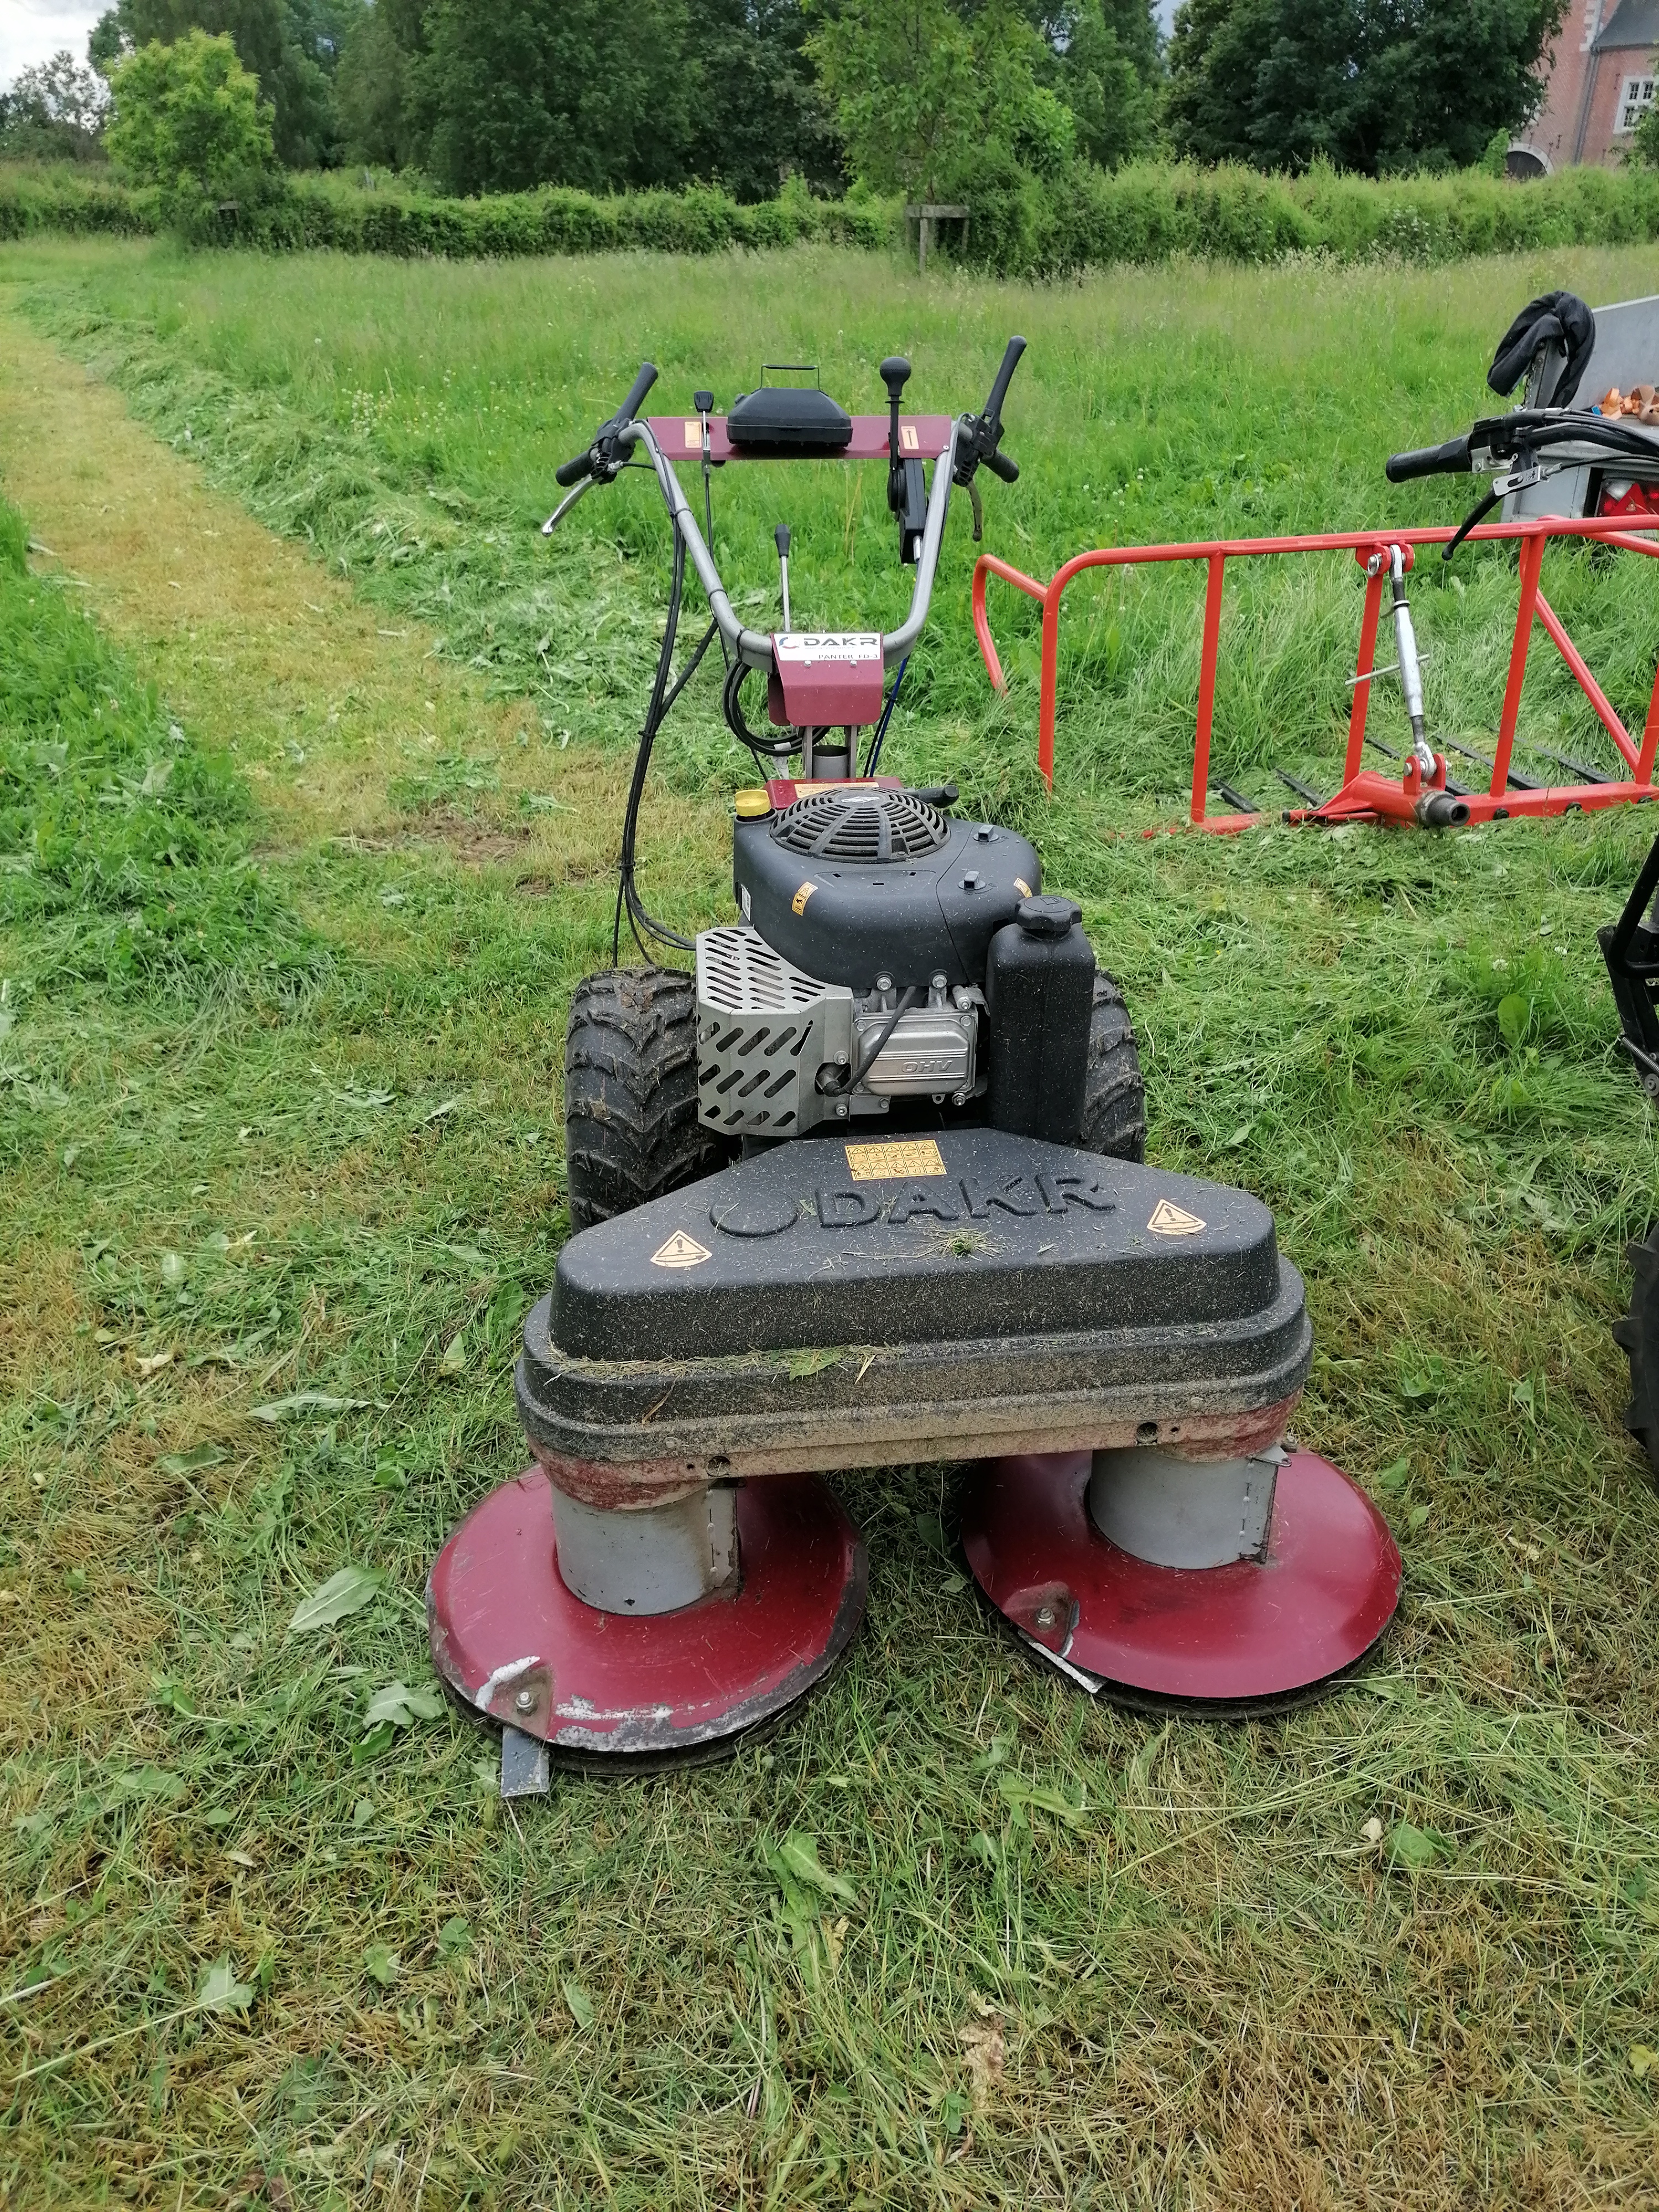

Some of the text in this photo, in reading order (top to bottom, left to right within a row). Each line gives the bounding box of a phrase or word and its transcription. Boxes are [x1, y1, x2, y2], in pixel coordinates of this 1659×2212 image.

[804, 638, 879, 646] DAKR
[901, 1060, 953, 1073] OHV
[814, 1172, 1116, 1229] DAKR
